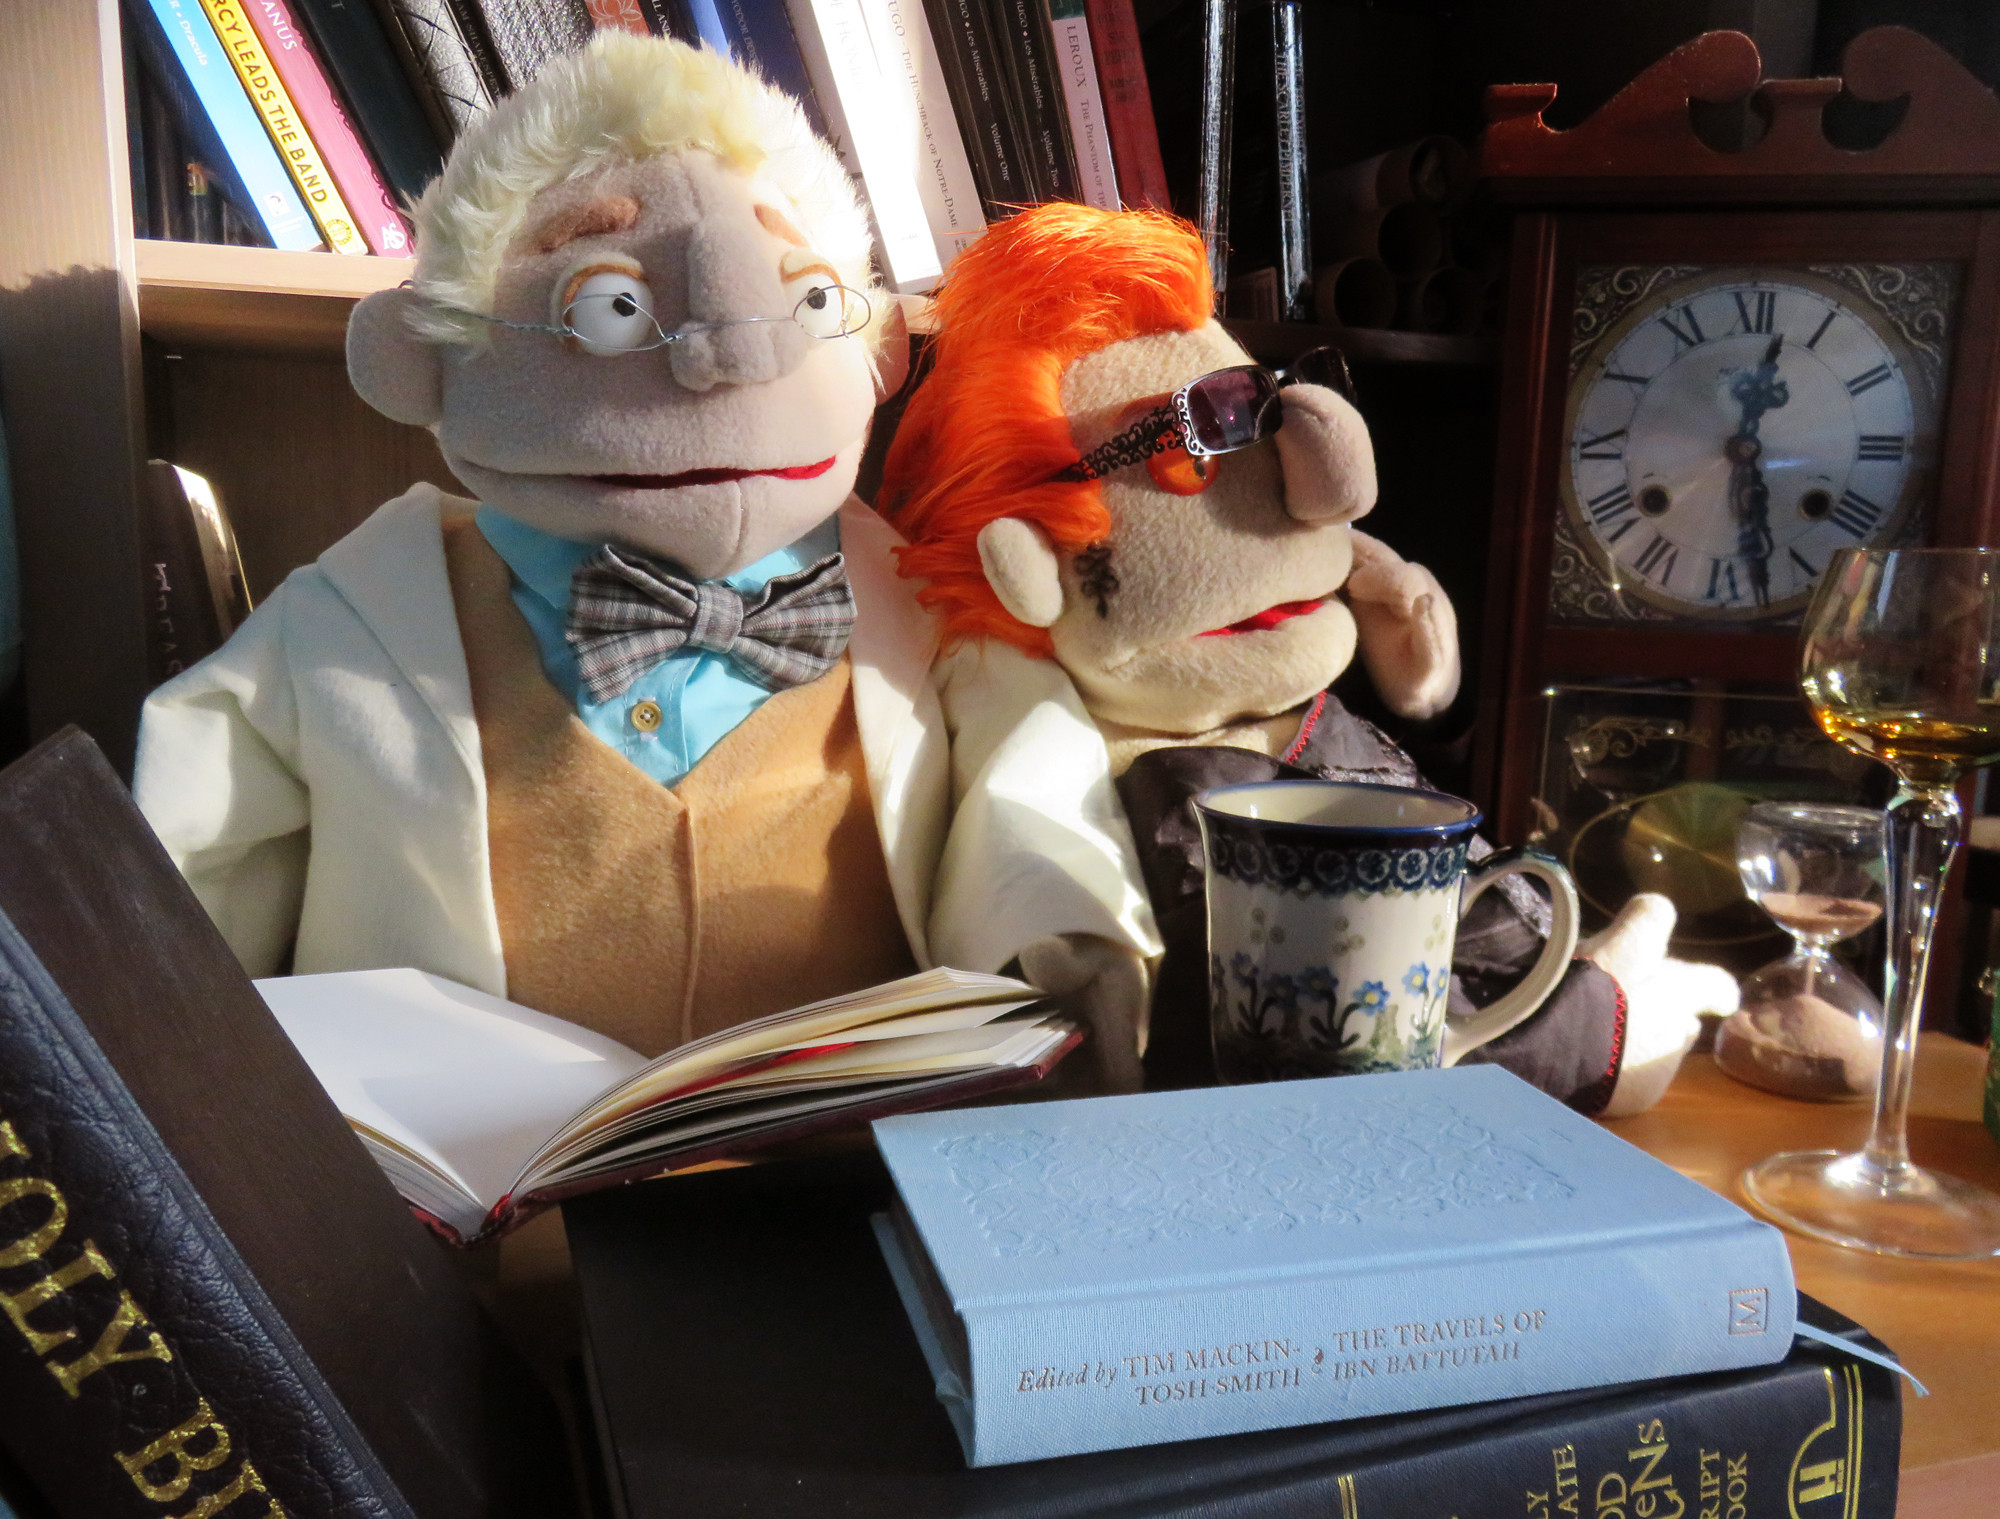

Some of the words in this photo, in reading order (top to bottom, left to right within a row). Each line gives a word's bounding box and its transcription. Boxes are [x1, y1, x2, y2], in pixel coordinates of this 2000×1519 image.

[179, 20, 208, 66] Dracula
[261, 0, 298, 50] ANUS
[466, 24, 500, 95] SHAKESPEA
[1066, 25, 1086, 88] LEROUX
[234, 40, 276, 101] LEADS
[268, 105, 298, 144] THE
[289, 148, 328, 203] BAND
[966, 30, 975, 47] Les
[990, 123, 1004, 159] Volume
[1000, 161, 1010, 181] One
[1024, 40, 1032, 55] Les
[1042, 130, 1054, 165] Volume
[1050, 168, 1060, 188] Two
[1081, 100, 1091, 120] THE
[902, 48, 914, 71] THE
[909, 74, 931, 140] HUNCHBACK
[928, 143, 938, 155] OF
[933, 158, 958, 228] NOTRE-DAME
[1085, 123, 1101, 173] PHANTOM
[1095, 176, 1103, 187] OF
[1844, 361, 1893, 397] II
[1857, 434, 1904, 461] III
[1333, 1326, 1388, 1354] THE
[1393, 1312, 1506, 1348] TRAVELS
[1513, 1309, 1547, 1333] OF
[1735, 1296, 1762, 1329] M
[1017, 1362, 1088, 1393] Edited
[1094, 1361, 1117, 1389] by
[1122, 1352, 1176, 1379] TIM
[1184, 1338, 1301, 1372] MACKIN-
[1333, 1357, 1377, 1382] IBN
[1386, 1341, 1521, 1375] BATTUTAH
[113, 1396, 287, 1519] BI
[1552, 1442, 1579, 1519] ATE,
